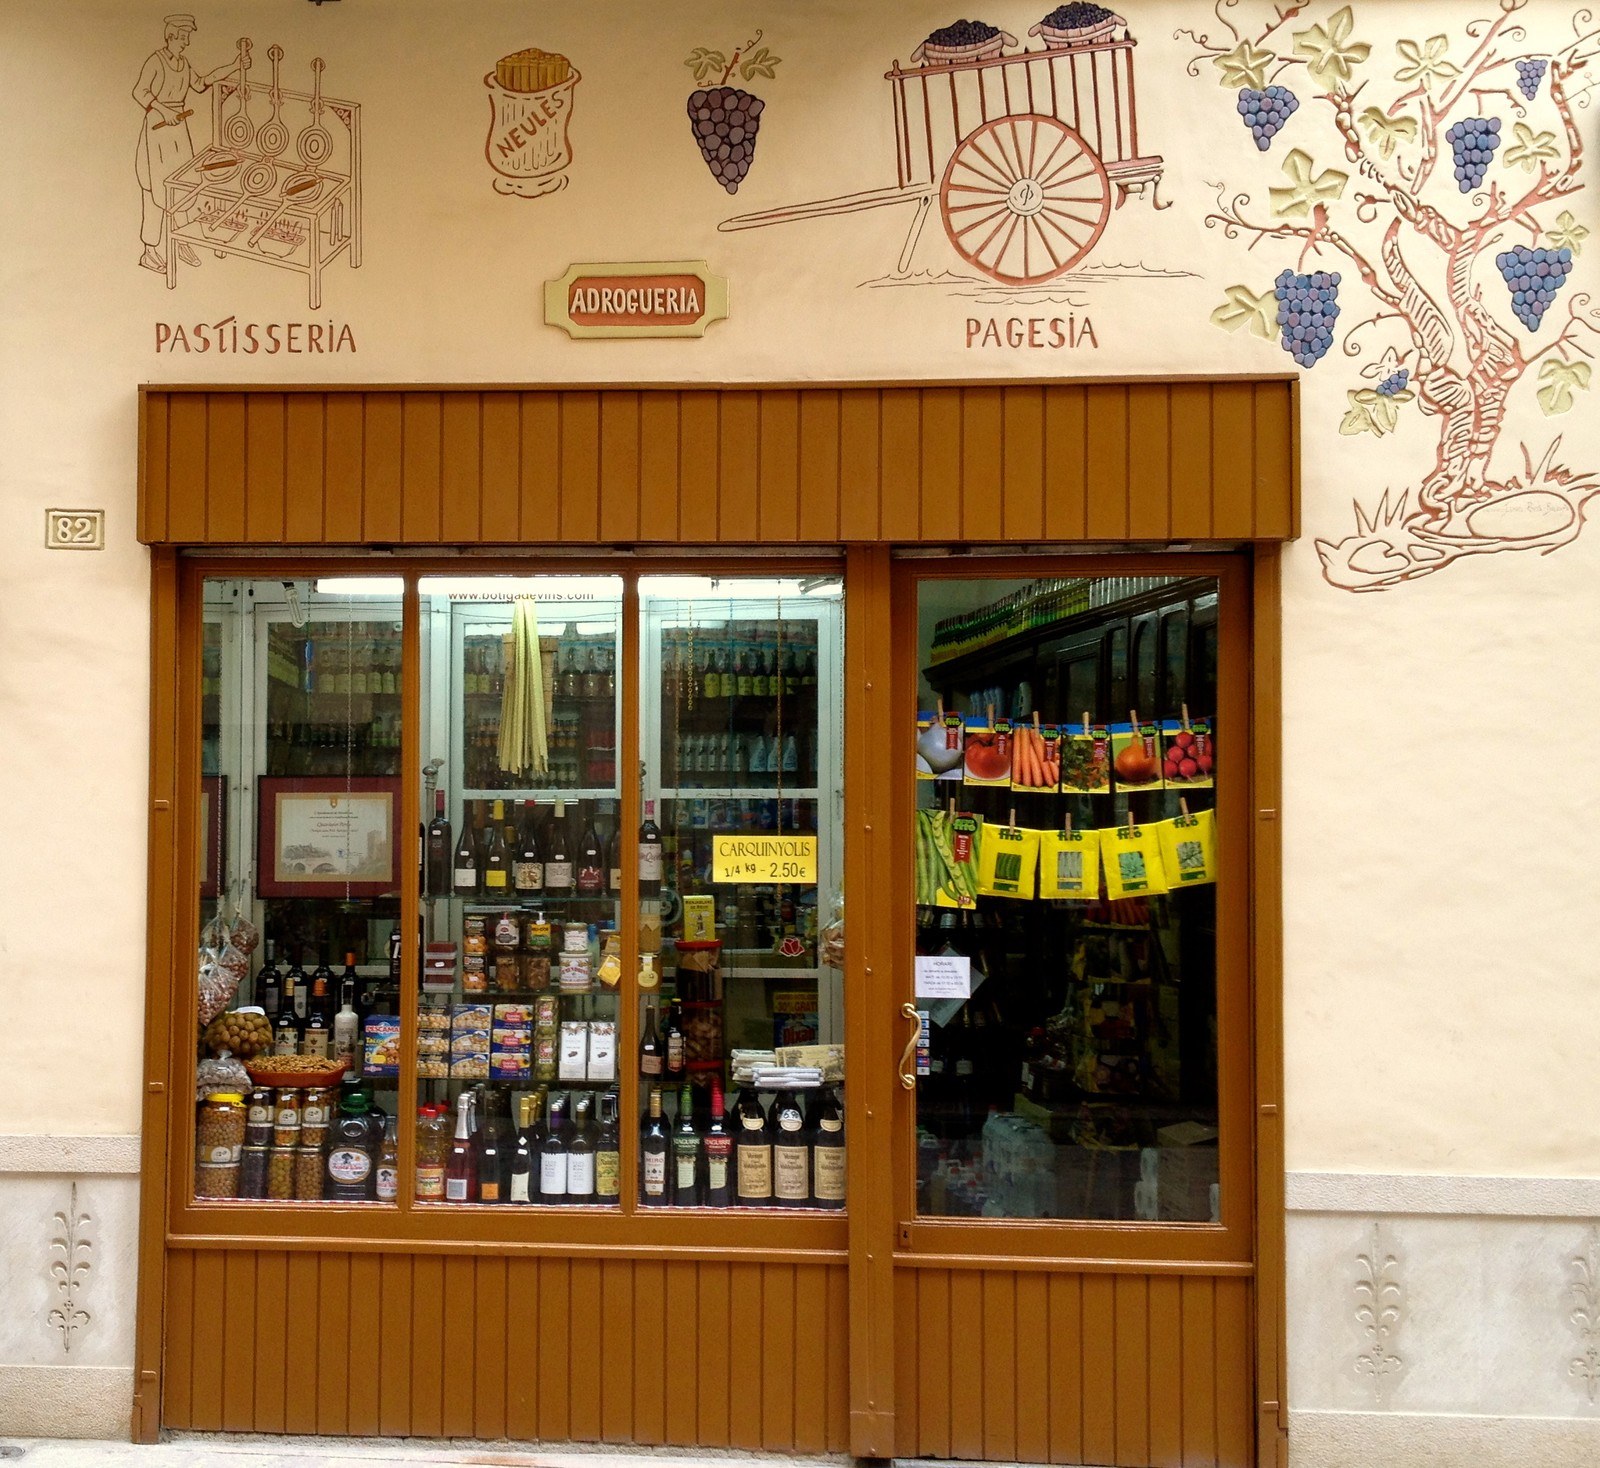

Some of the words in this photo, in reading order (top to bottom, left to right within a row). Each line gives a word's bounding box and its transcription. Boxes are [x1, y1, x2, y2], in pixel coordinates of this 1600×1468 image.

[496, 90, 564, 158] NEULES
[570, 287, 700, 315] ADROGUERIA
[57, 517, 93, 542] 82
[719, 841, 810, 857] CARQUINYOLIS
[725, 865, 740, 877] 1/4
[745, 863, 756, 873] kg
[769, 862, 806, 877] 2.50€
[365, 1025, 401, 1033] PESCAMA
